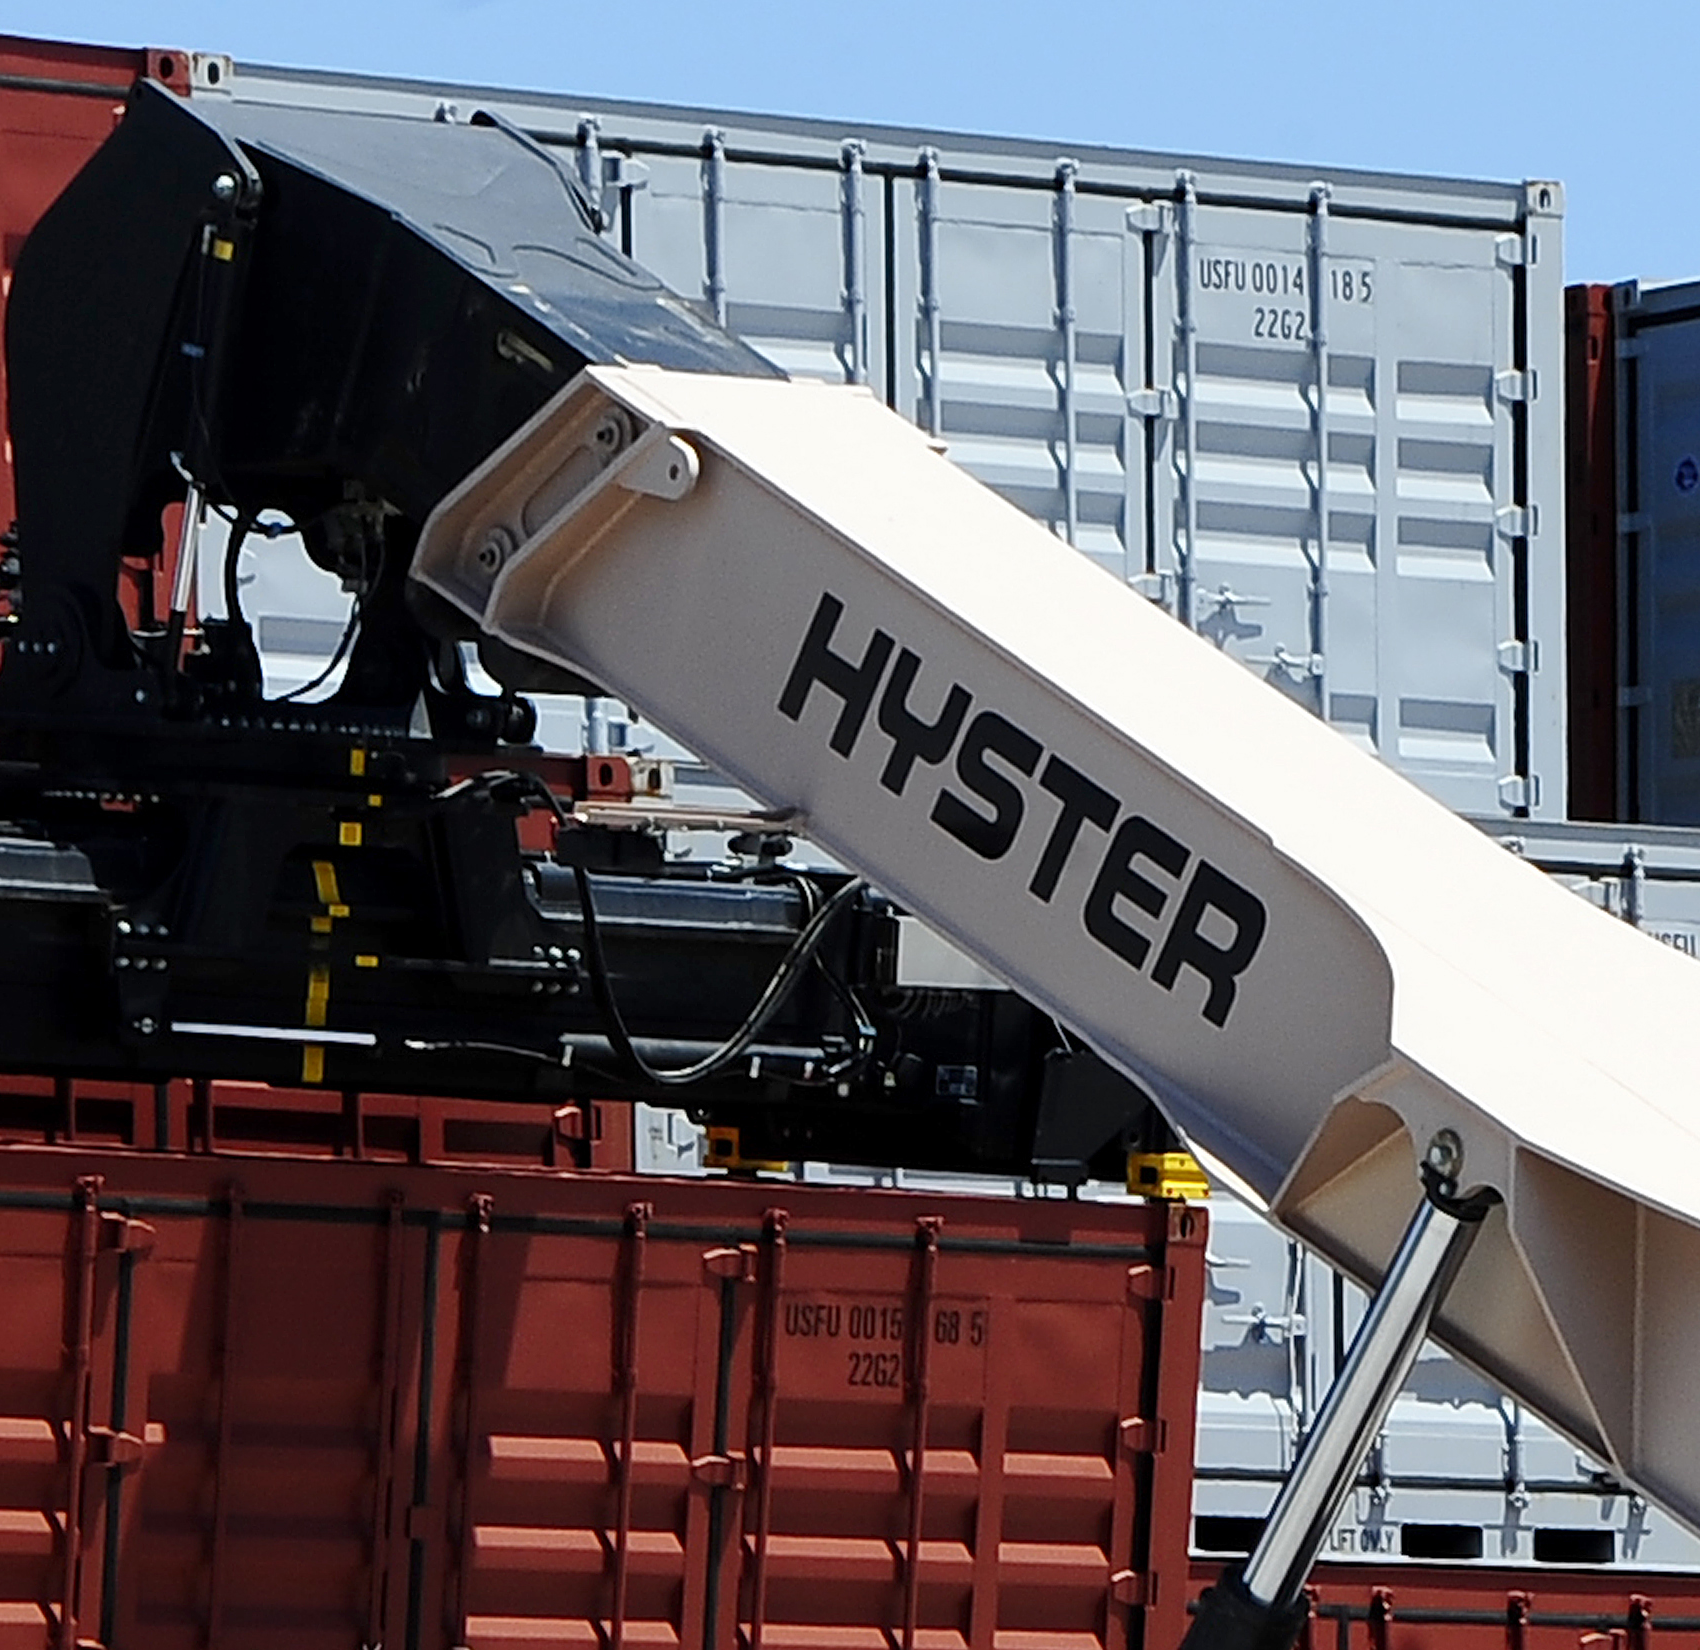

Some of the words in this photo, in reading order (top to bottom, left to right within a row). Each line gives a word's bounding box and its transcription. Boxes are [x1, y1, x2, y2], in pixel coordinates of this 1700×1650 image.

[1200, 258, 1245, 292] USFU
[1252, 263, 1304, 297] 0014
[1359, 271, 1372, 303] 5
[1254, 307, 1305, 341] 22G2
[778, 592, 1267, 1029] HYSTER
[784, 1303, 841, 1337] USFU
[849, 1305, 902, 1340] 0015
[970, 1312, 984, 1347] 5
[848, 1352, 900, 1388] 22G2
